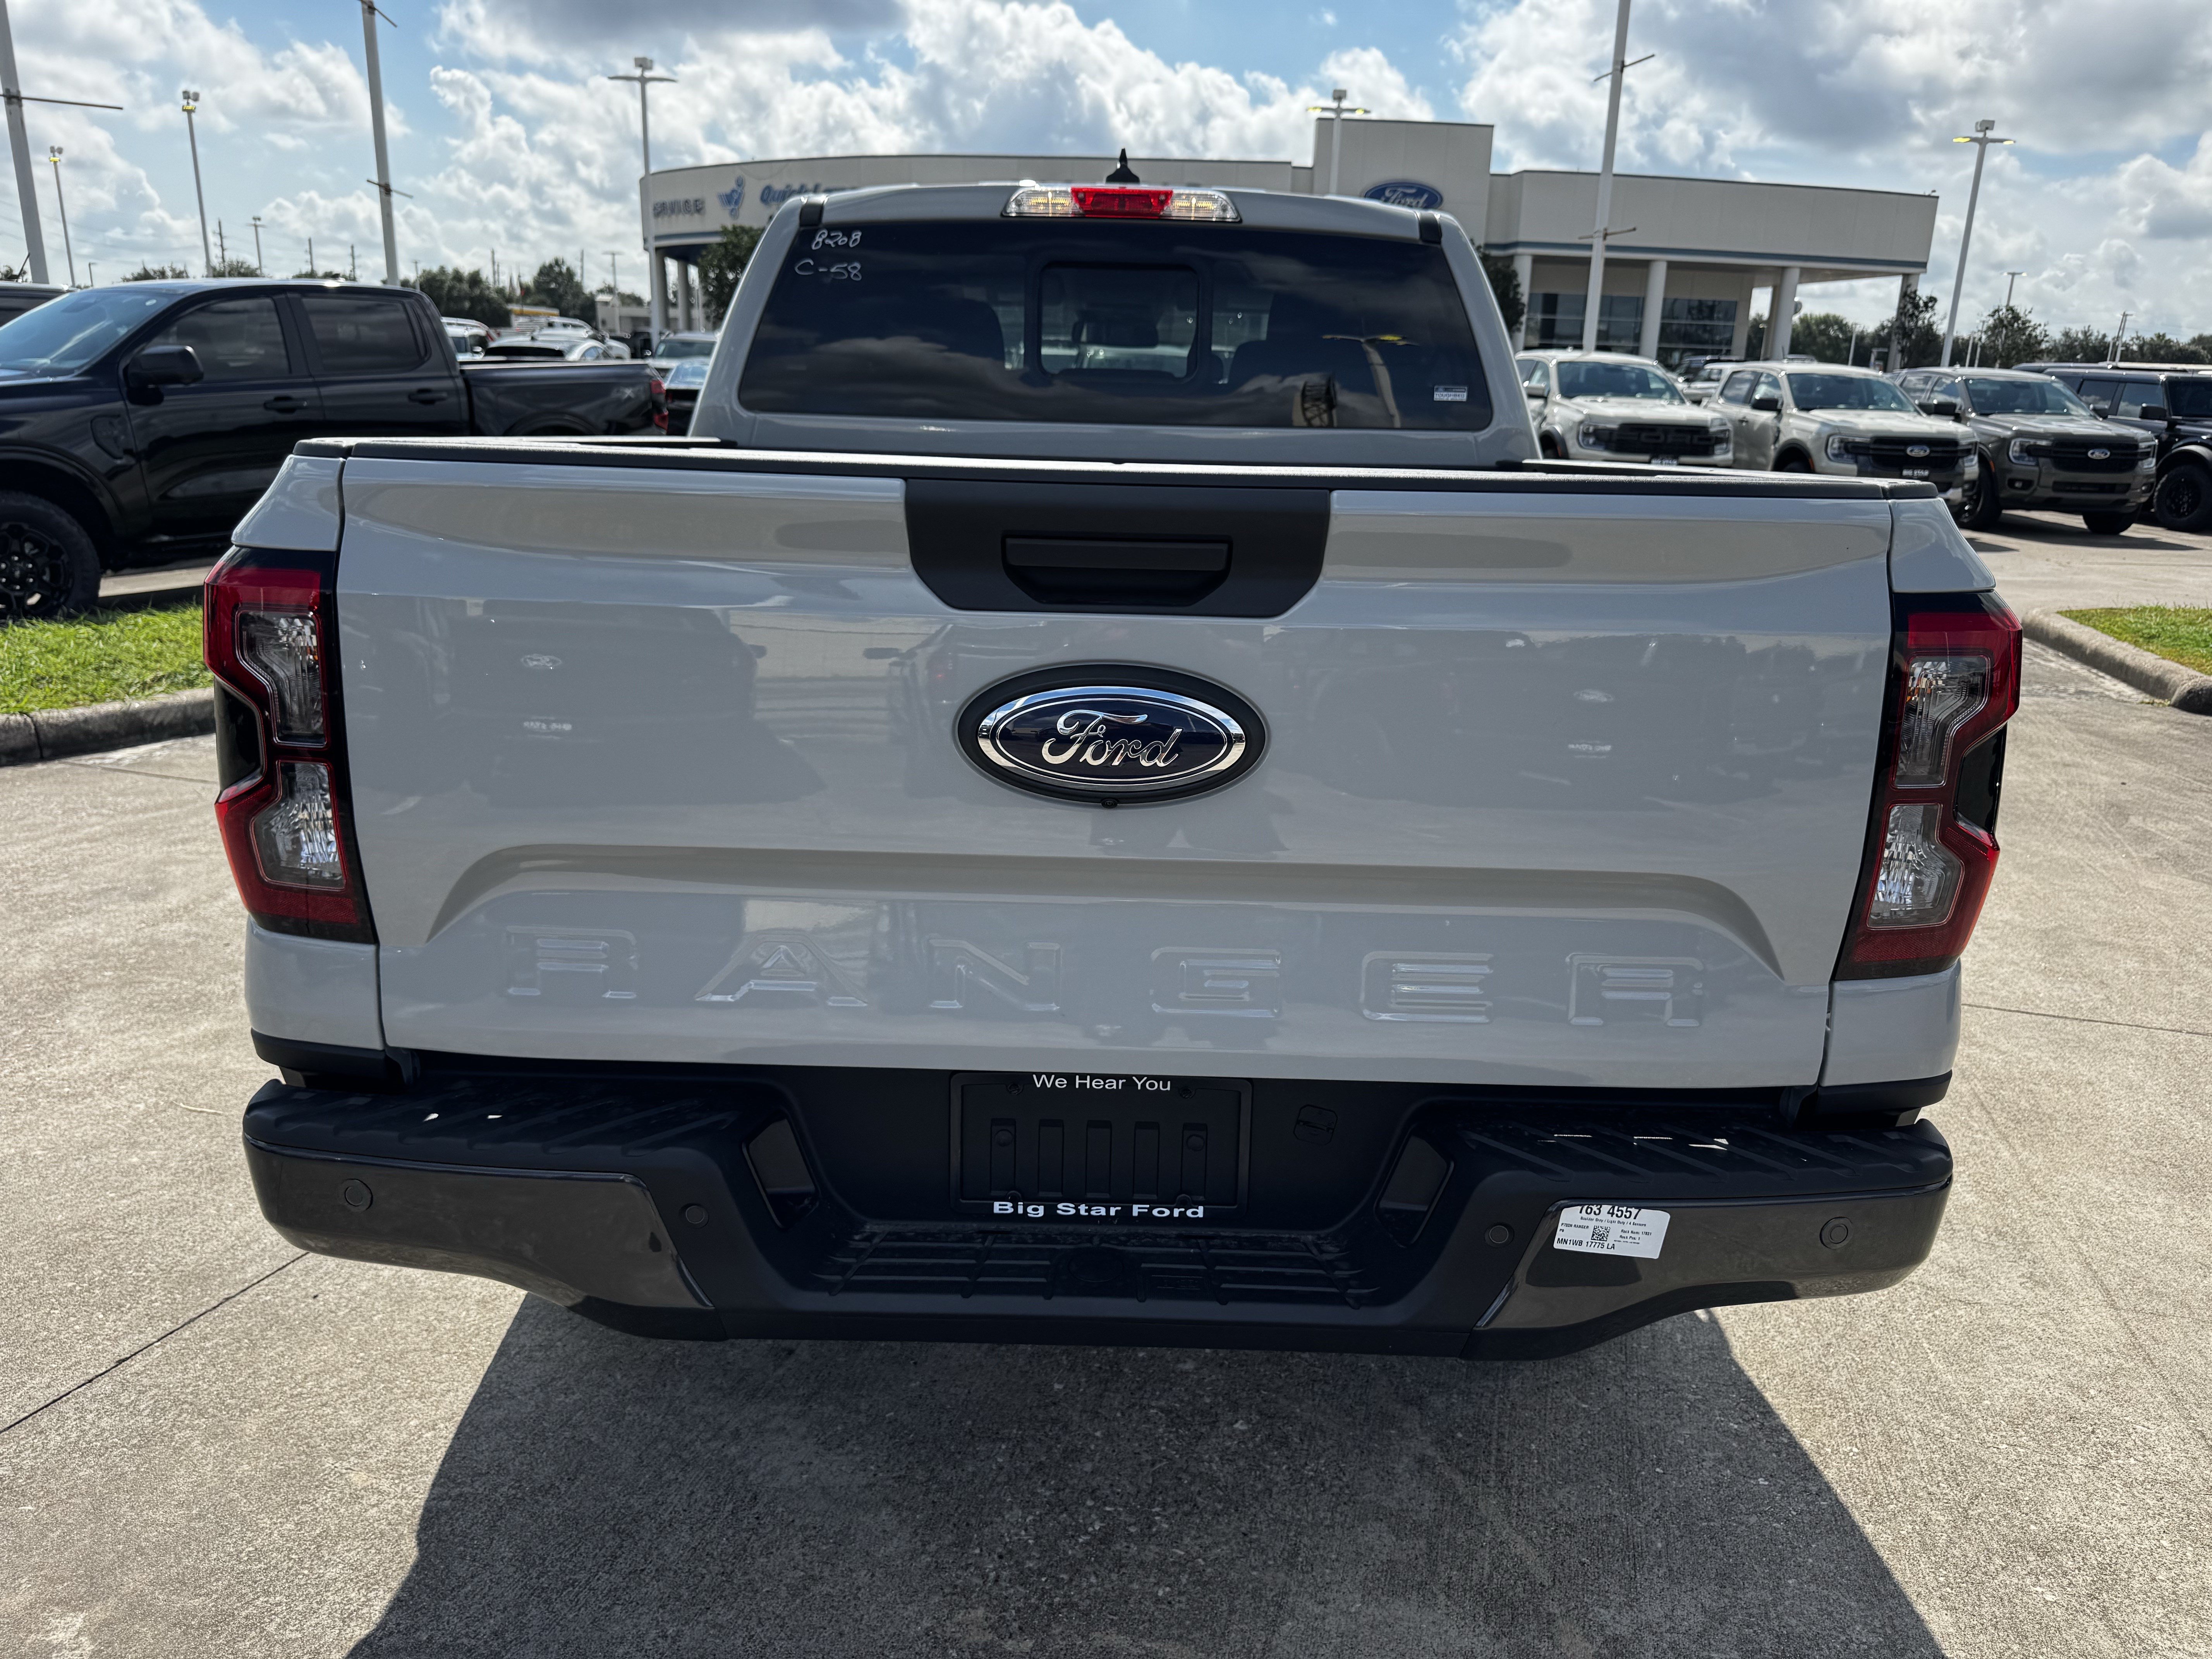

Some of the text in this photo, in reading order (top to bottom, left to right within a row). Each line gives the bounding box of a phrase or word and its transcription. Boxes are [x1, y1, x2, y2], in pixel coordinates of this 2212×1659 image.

[1381, 187, 1428, 208] Ford
[811, 228, 862, 250] 8208
[795, 258, 862, 281] C-58
[1042, 709, 1182, 767] Ford
[505, 926, 1703, 1027] RANGER
[1032, 1075, 1171, 1091] We Hear You
[993, 1201, 1204, 1218] Big Star Ford
[1607, 1205, 1642, 1219] 4557
[1557, 1238, 1583, 1246] MN1WB
